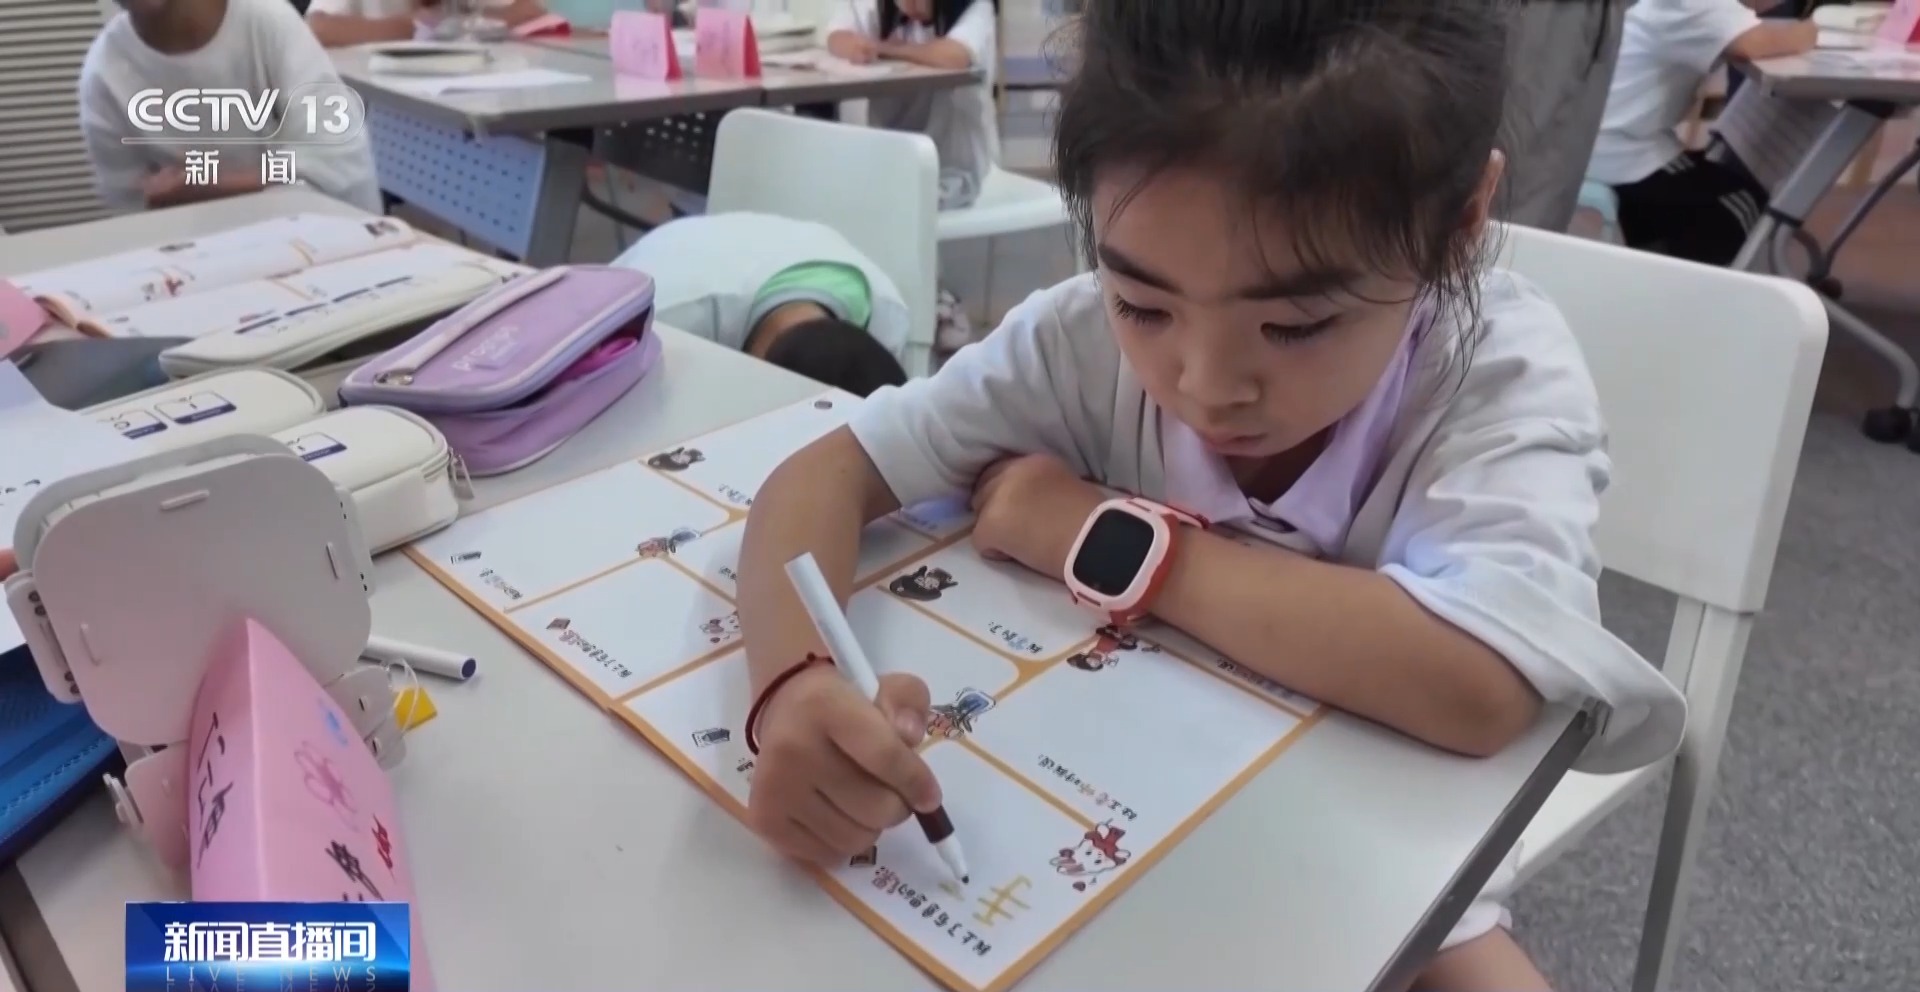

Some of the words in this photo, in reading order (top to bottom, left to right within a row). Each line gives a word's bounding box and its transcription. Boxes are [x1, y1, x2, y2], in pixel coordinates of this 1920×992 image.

[871, 866, 992, 956] 我上了有意思的课：
